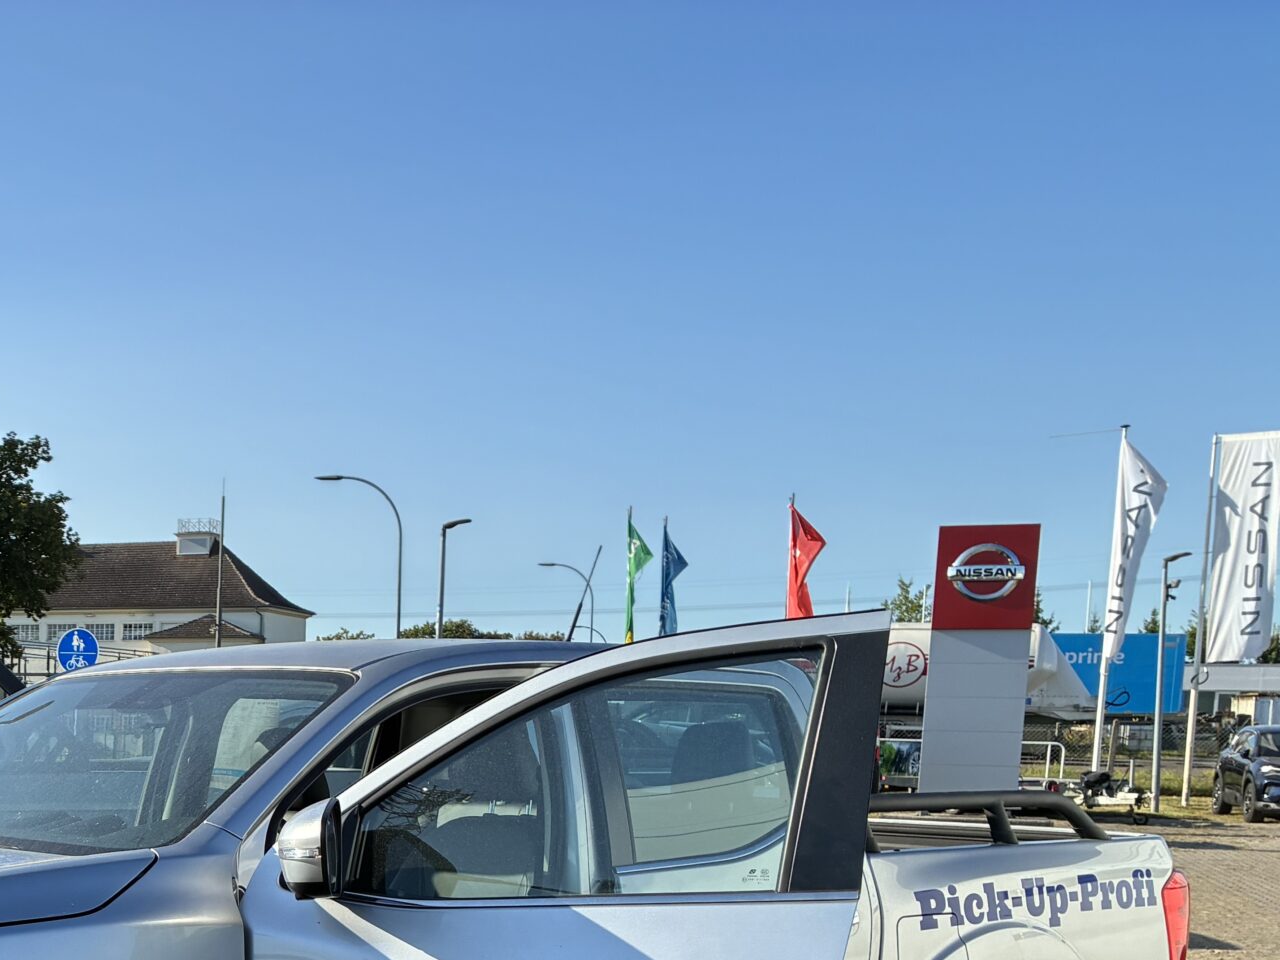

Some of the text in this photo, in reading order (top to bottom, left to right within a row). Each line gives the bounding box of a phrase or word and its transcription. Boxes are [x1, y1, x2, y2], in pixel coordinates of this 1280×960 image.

[1240, 461, 1274, 636] NISSAN
[956, 567, 1017, 577] NISSAN
[1065, 647, 1125, 664] prie
[913, 868, 1158, 931] Pick-Up-Profi
